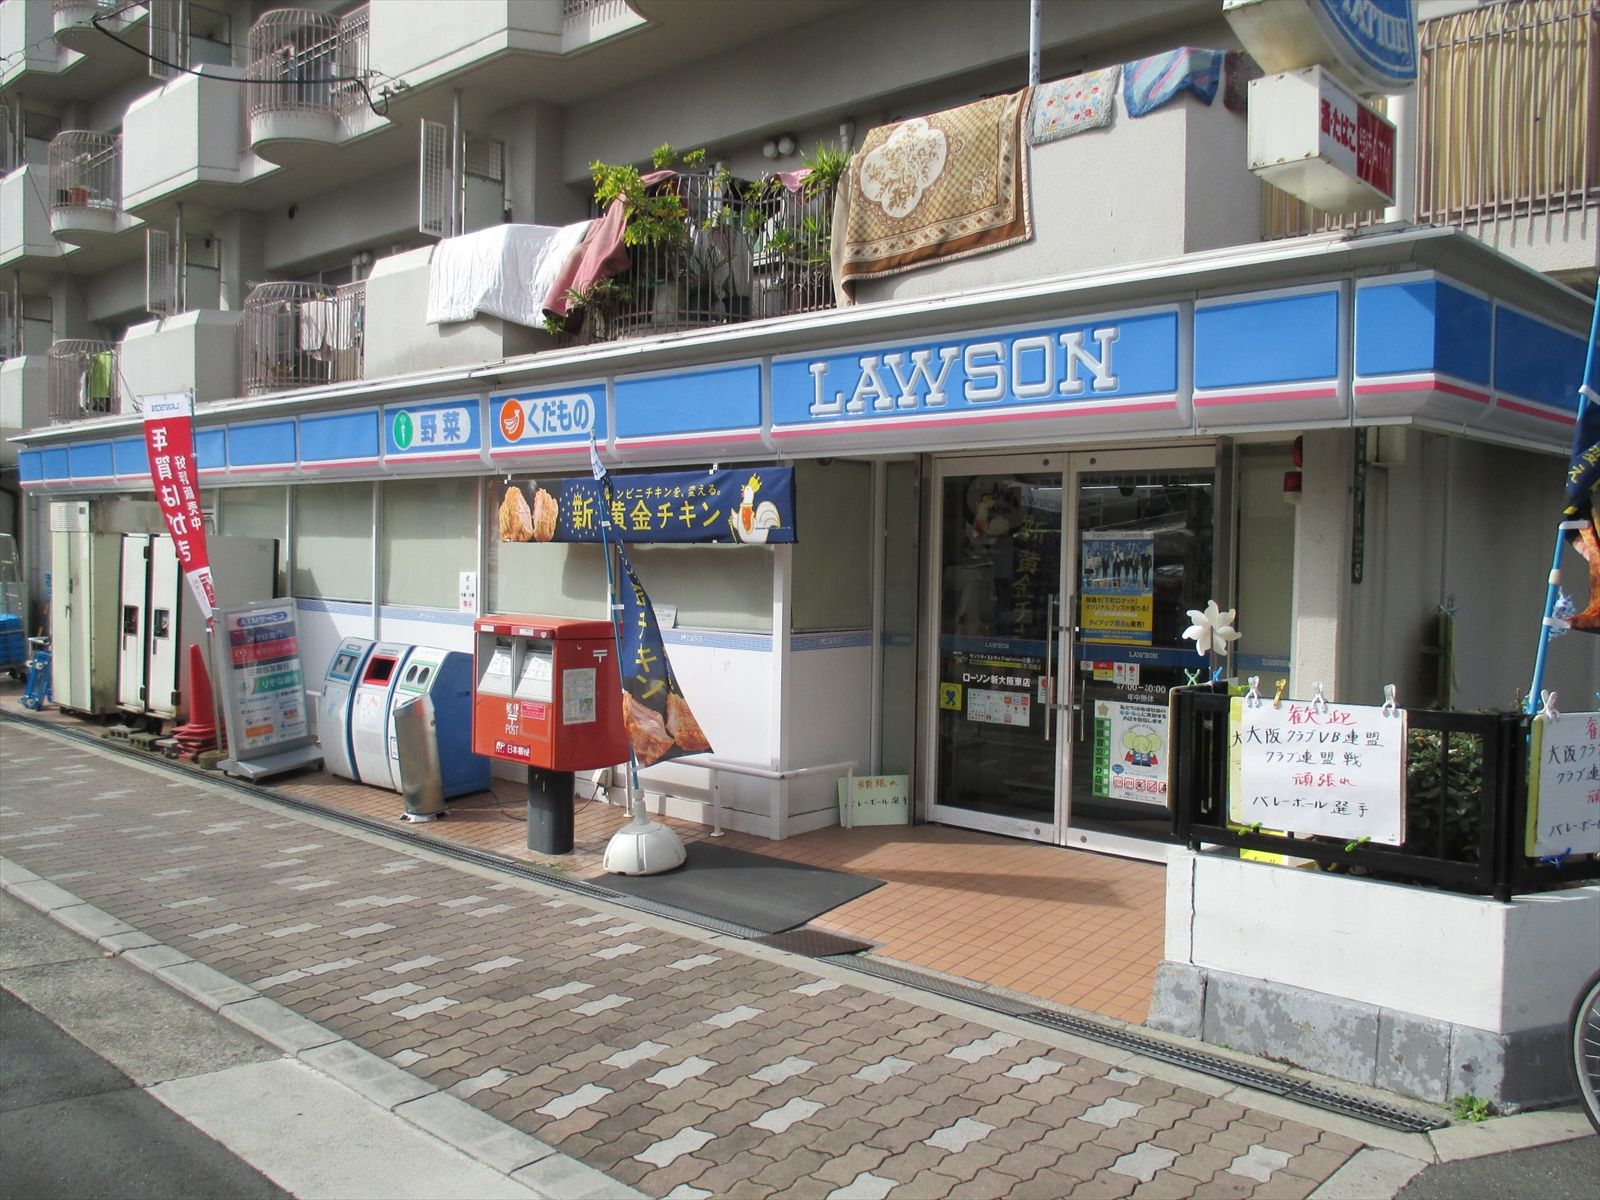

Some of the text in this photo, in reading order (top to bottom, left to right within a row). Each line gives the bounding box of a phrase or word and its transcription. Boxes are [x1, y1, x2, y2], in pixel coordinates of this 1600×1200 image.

[808, 327, 1119, 416] LAWSON
[526, 398, 589, 434] くだもの
[420, 411, 461, 443] 野菜
[616, 484, 721, 500] ンビニチキンを、変える。
[962, 672, 1031, 688] ローソン新大阪東店
[1287, 704, 1358, 726] 歓迎
[504, 723, 519, 737] POST
[1265, 751, 1362, 768] クラブ連盟戦
[1547, 744, 1600, 765] 大阪クラ
[1291, 771, 1358, 788] 頑張れ
